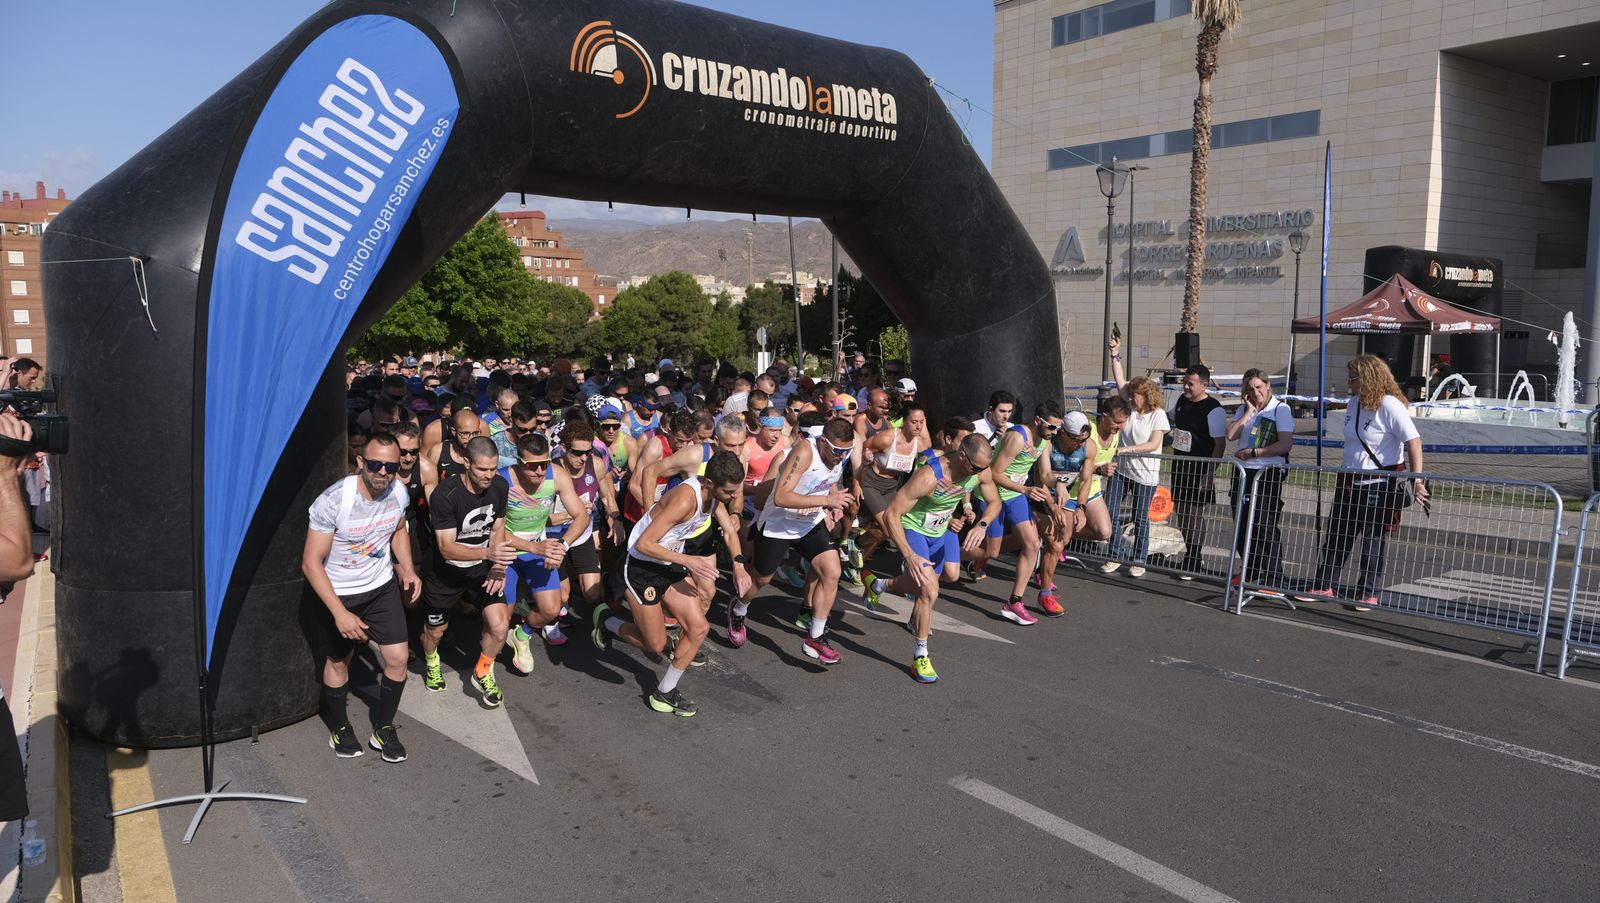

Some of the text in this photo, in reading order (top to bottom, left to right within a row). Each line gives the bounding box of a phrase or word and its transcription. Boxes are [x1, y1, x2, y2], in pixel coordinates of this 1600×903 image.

[743, 107, 897, 142] cronometraje deportivo
[334, 117, 450, 301] centrohogarsanchez.es
[1111, 207, 1315, 238] OSPITAL IVERSITARIO
[1130, 240, 1284, 262] TORRERDENAS
